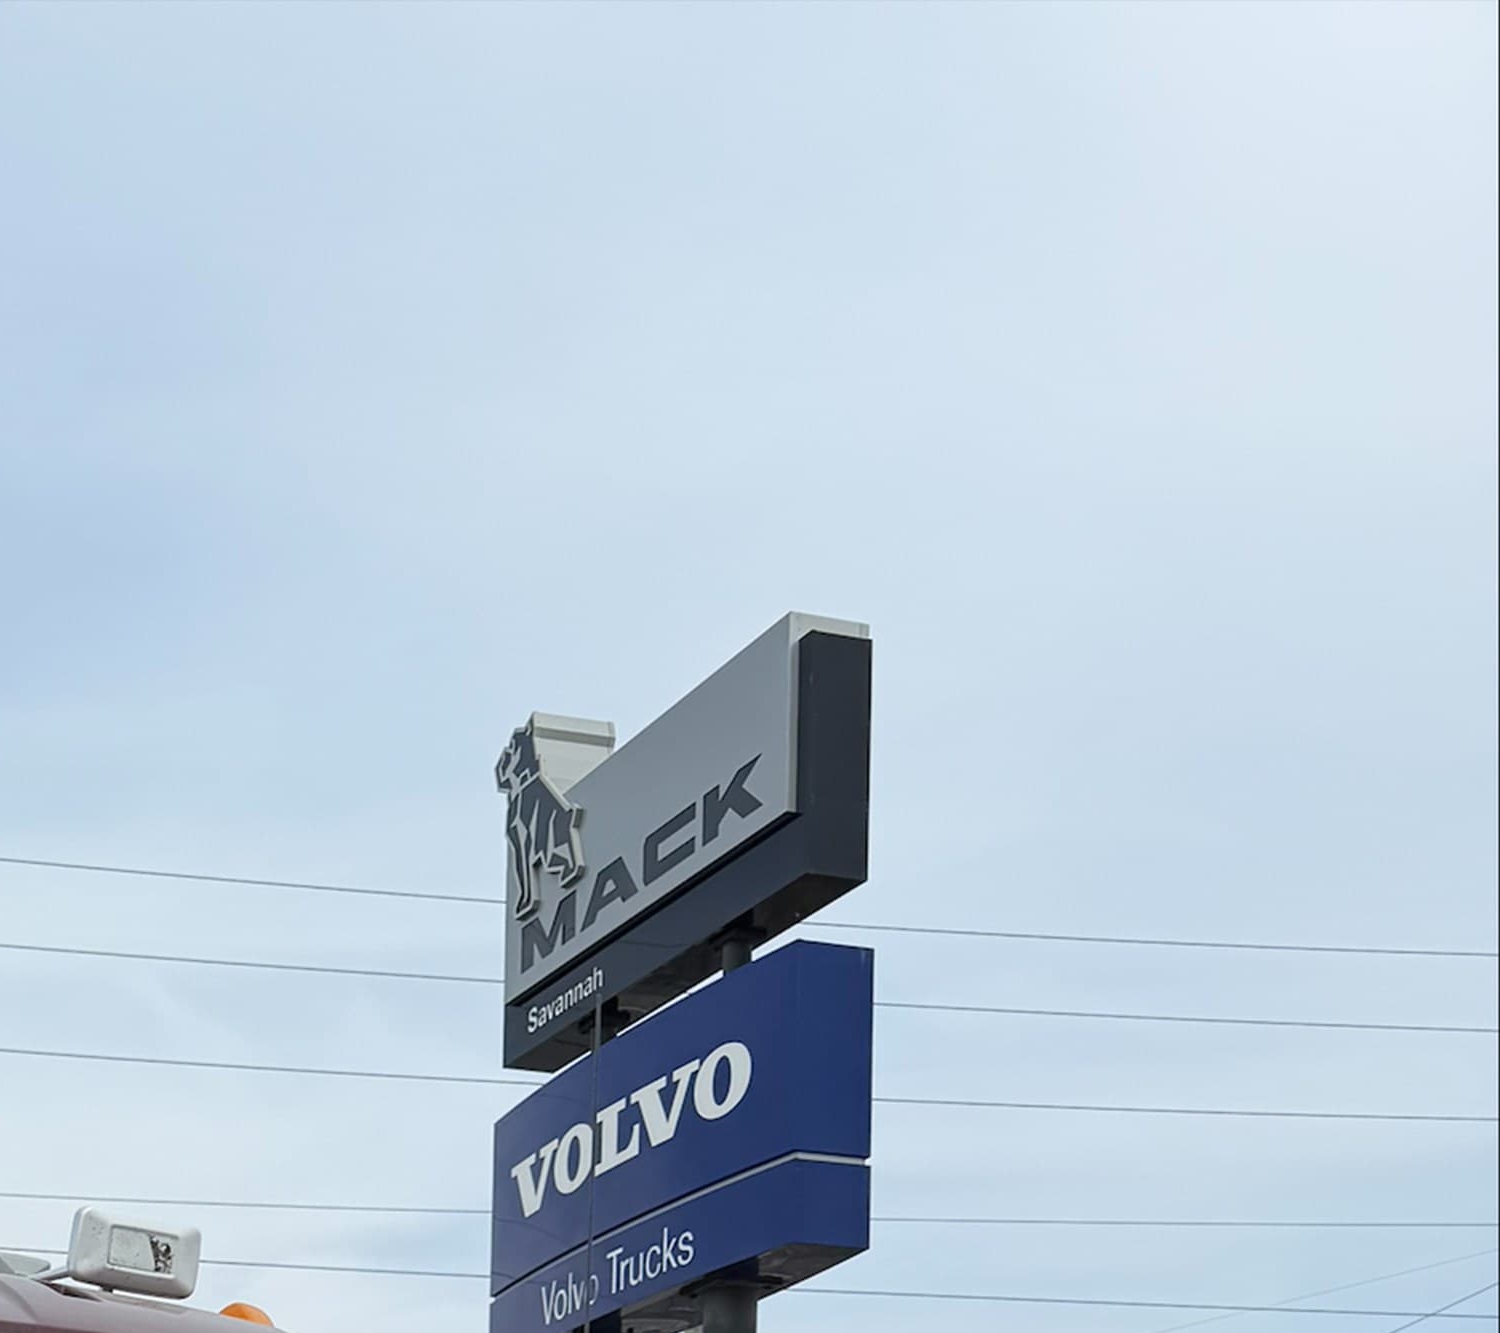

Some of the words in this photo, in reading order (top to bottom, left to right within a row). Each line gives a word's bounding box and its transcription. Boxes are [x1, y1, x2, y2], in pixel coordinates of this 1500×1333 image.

[521, 753, 763, 974] MACK
[527, 966, 603, 1033] Savannah
[511, 1041, 752, 1218] VOLVO
[606, 1227, 694, 1294] Trucks
